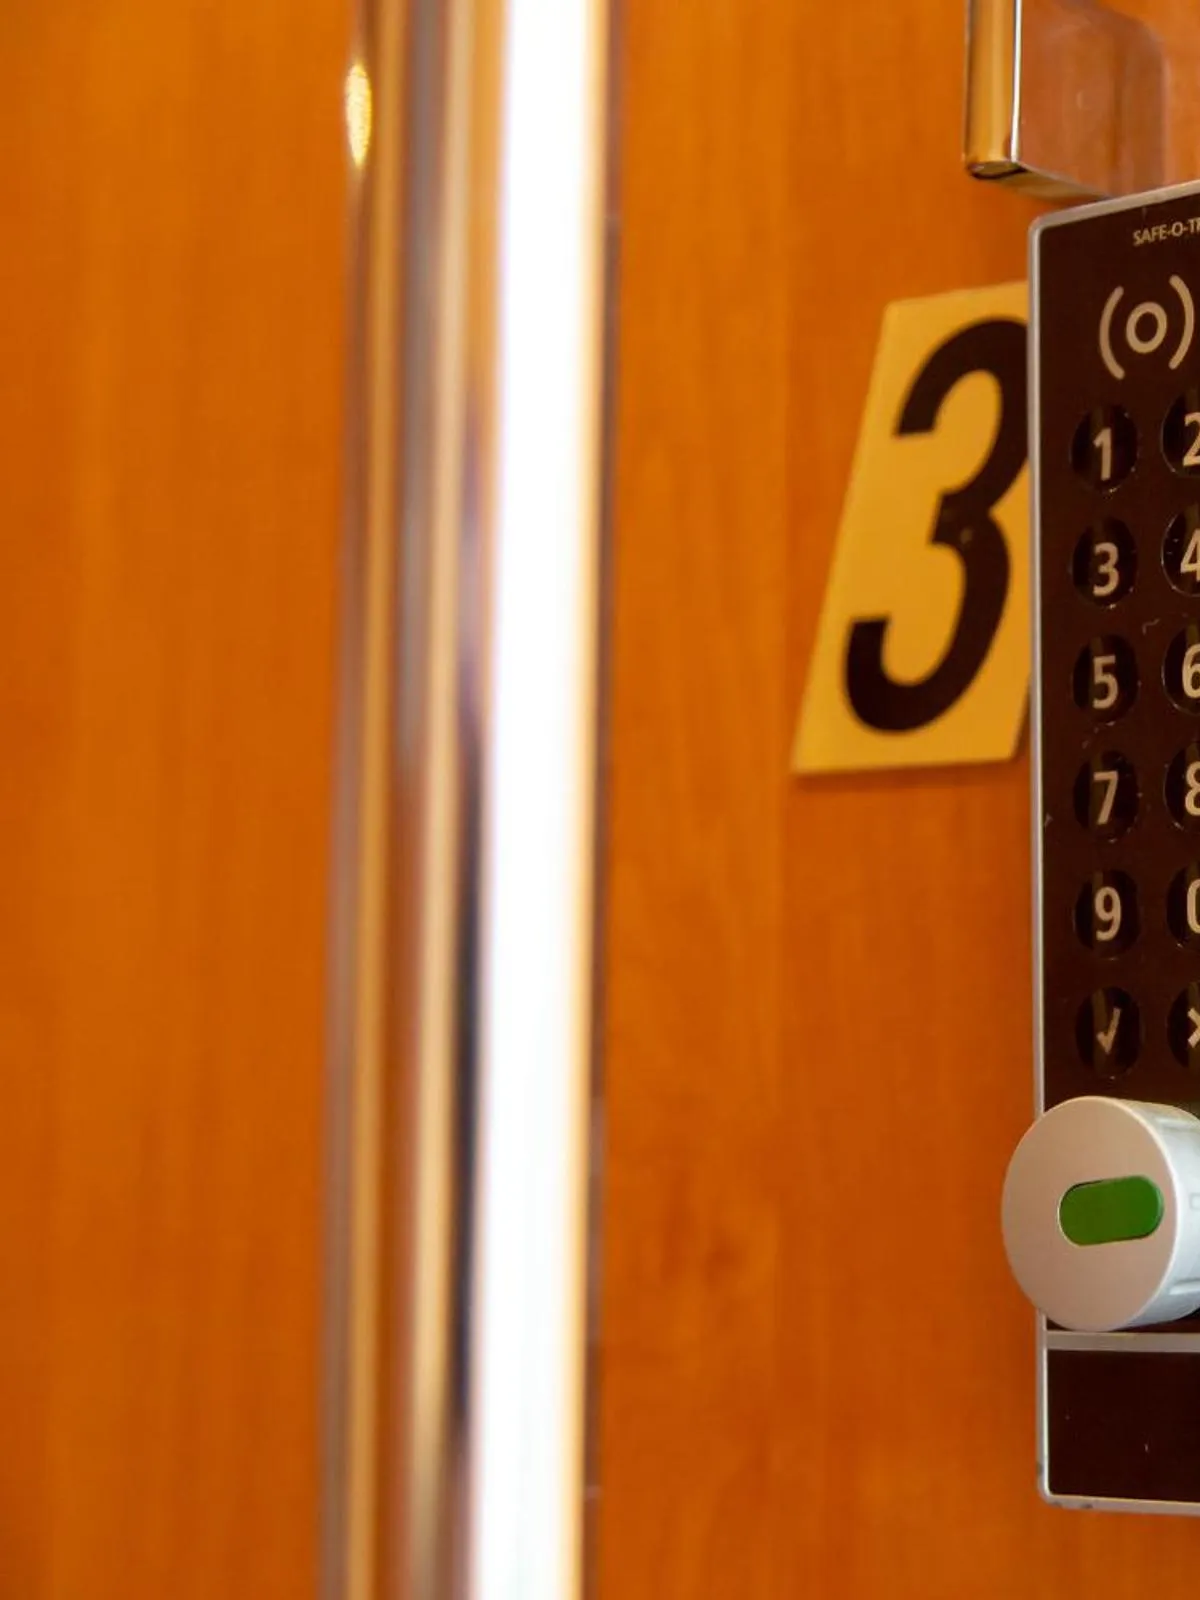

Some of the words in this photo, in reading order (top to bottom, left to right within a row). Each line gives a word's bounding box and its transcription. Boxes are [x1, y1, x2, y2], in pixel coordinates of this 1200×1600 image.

[1093, 428, 1112, 480] 1
[843, 318, 1029, 736] 3
[1093, 542, 1119, 596] 3
[1093, 655, 1118, 709] 5
[1093, 770, 1118, 825] 7
[1094, 886, 1122, 941] 9
